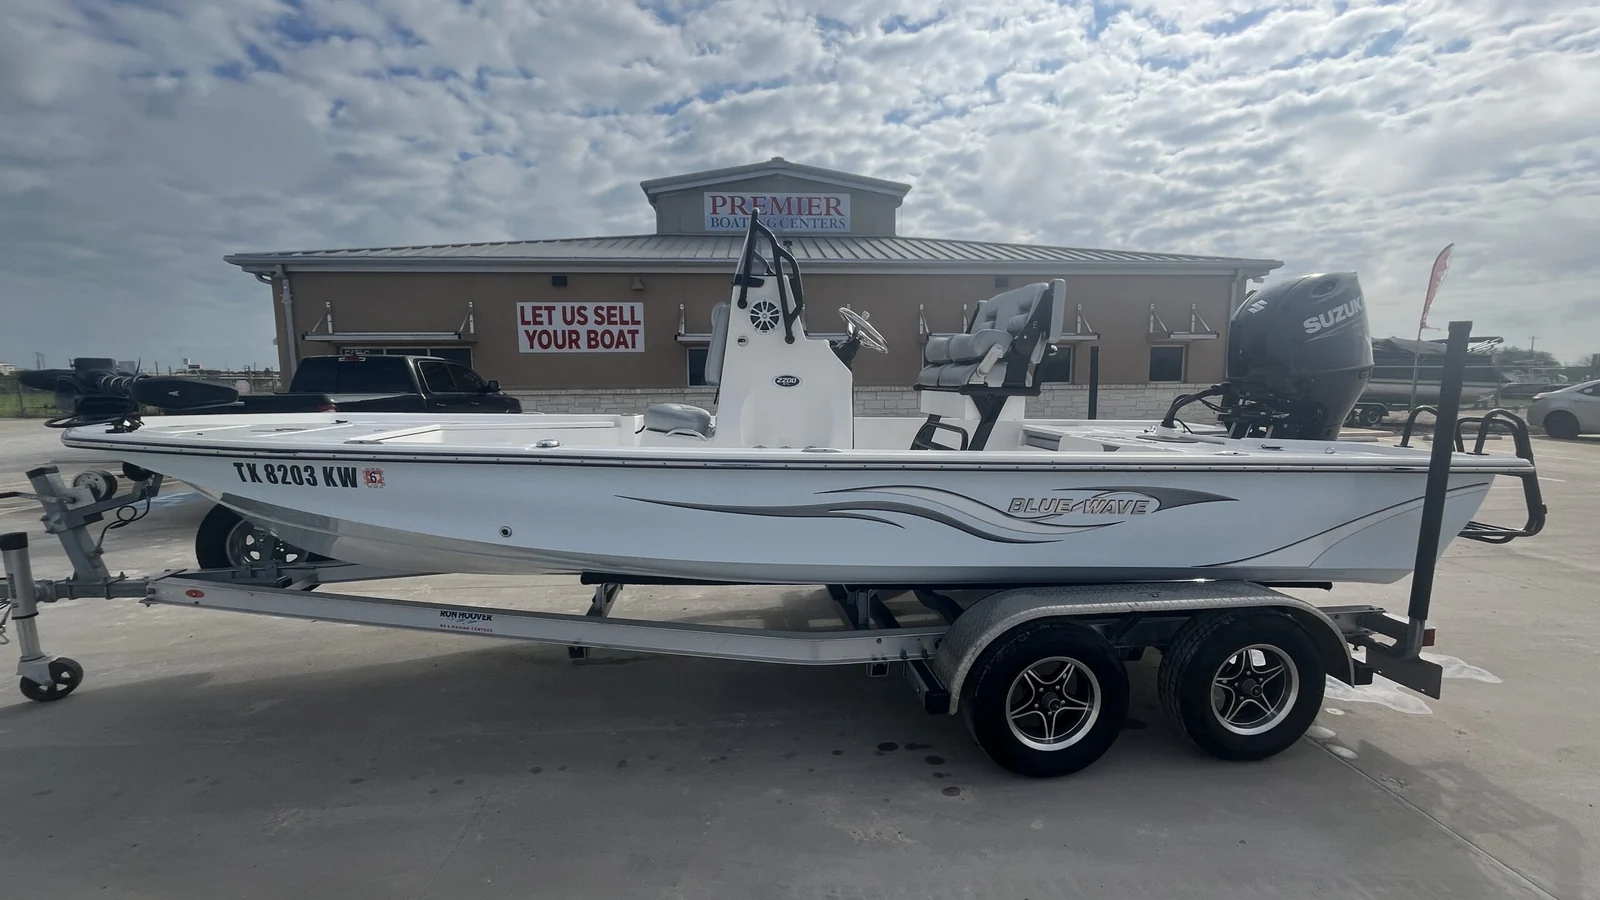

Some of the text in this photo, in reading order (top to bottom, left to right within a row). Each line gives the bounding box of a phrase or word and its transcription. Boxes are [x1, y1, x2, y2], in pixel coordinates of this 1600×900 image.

[709, 195, 845, 216] PREMIER
[711, 216, 846, 229] BOATNG CENTERS
[519, 305, 642, 326] LET US SELL
[524, 329, 640, 350] YOUR BOAT
[233, 462, 358, 489] TX 8203 KW
[369, 471, 377, 483] 6
[1008, 497, 1150, 515] BLUE WAVE
[440, 610, 493, 621] RON HOOVER
